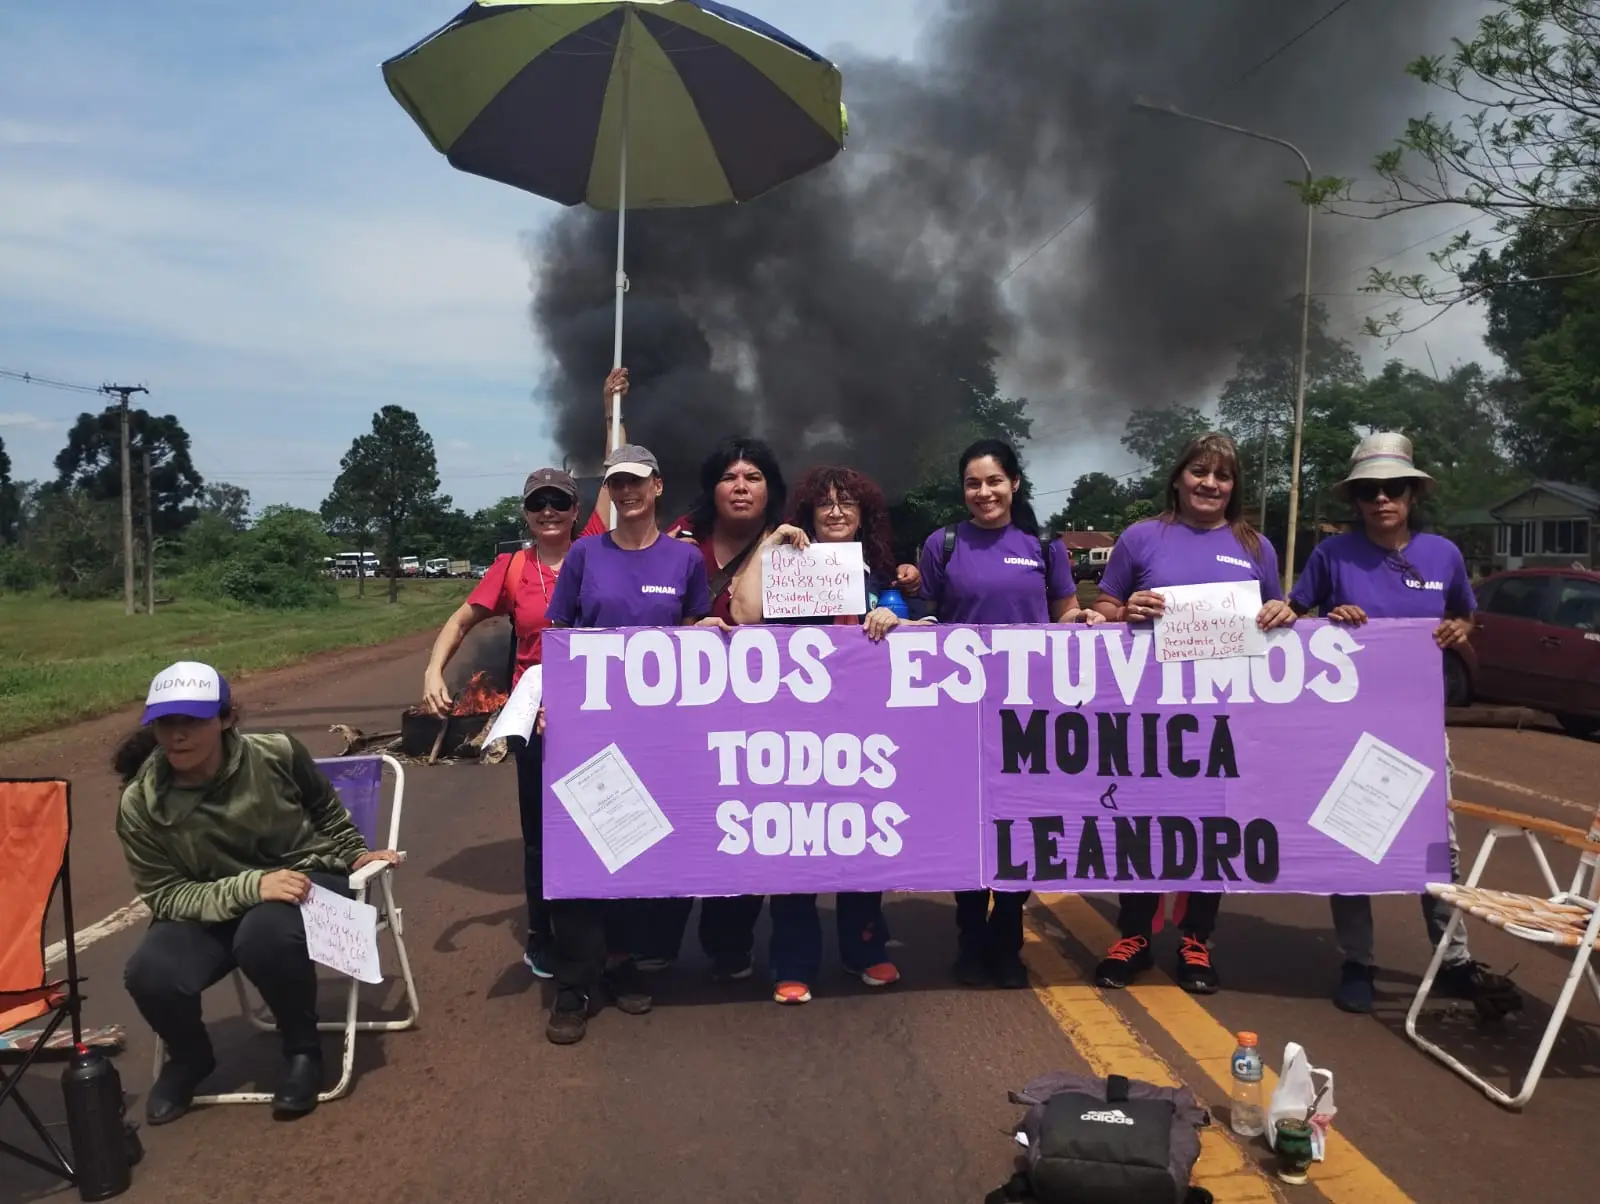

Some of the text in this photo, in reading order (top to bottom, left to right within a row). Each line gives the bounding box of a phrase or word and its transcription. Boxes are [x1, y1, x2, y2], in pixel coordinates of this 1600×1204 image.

[641, 585, 676, 595] UDNAM
[1003, 557, 1038, 568] UDNAM
[154, 678, 212, 692] UDNAM
[568, 628, 838, 710] TODOS
[885, 625, 1365, 708] ESTUVIMOS
[707, 730, 900, 789] TODOS
[998, 700, 1241, 778] MÓNICA
[715, 799, 911, 857] SOMOS
[992, 815, 1280, 884] LEANDRO
[1080, 1110, 1134, 1125] adidas
